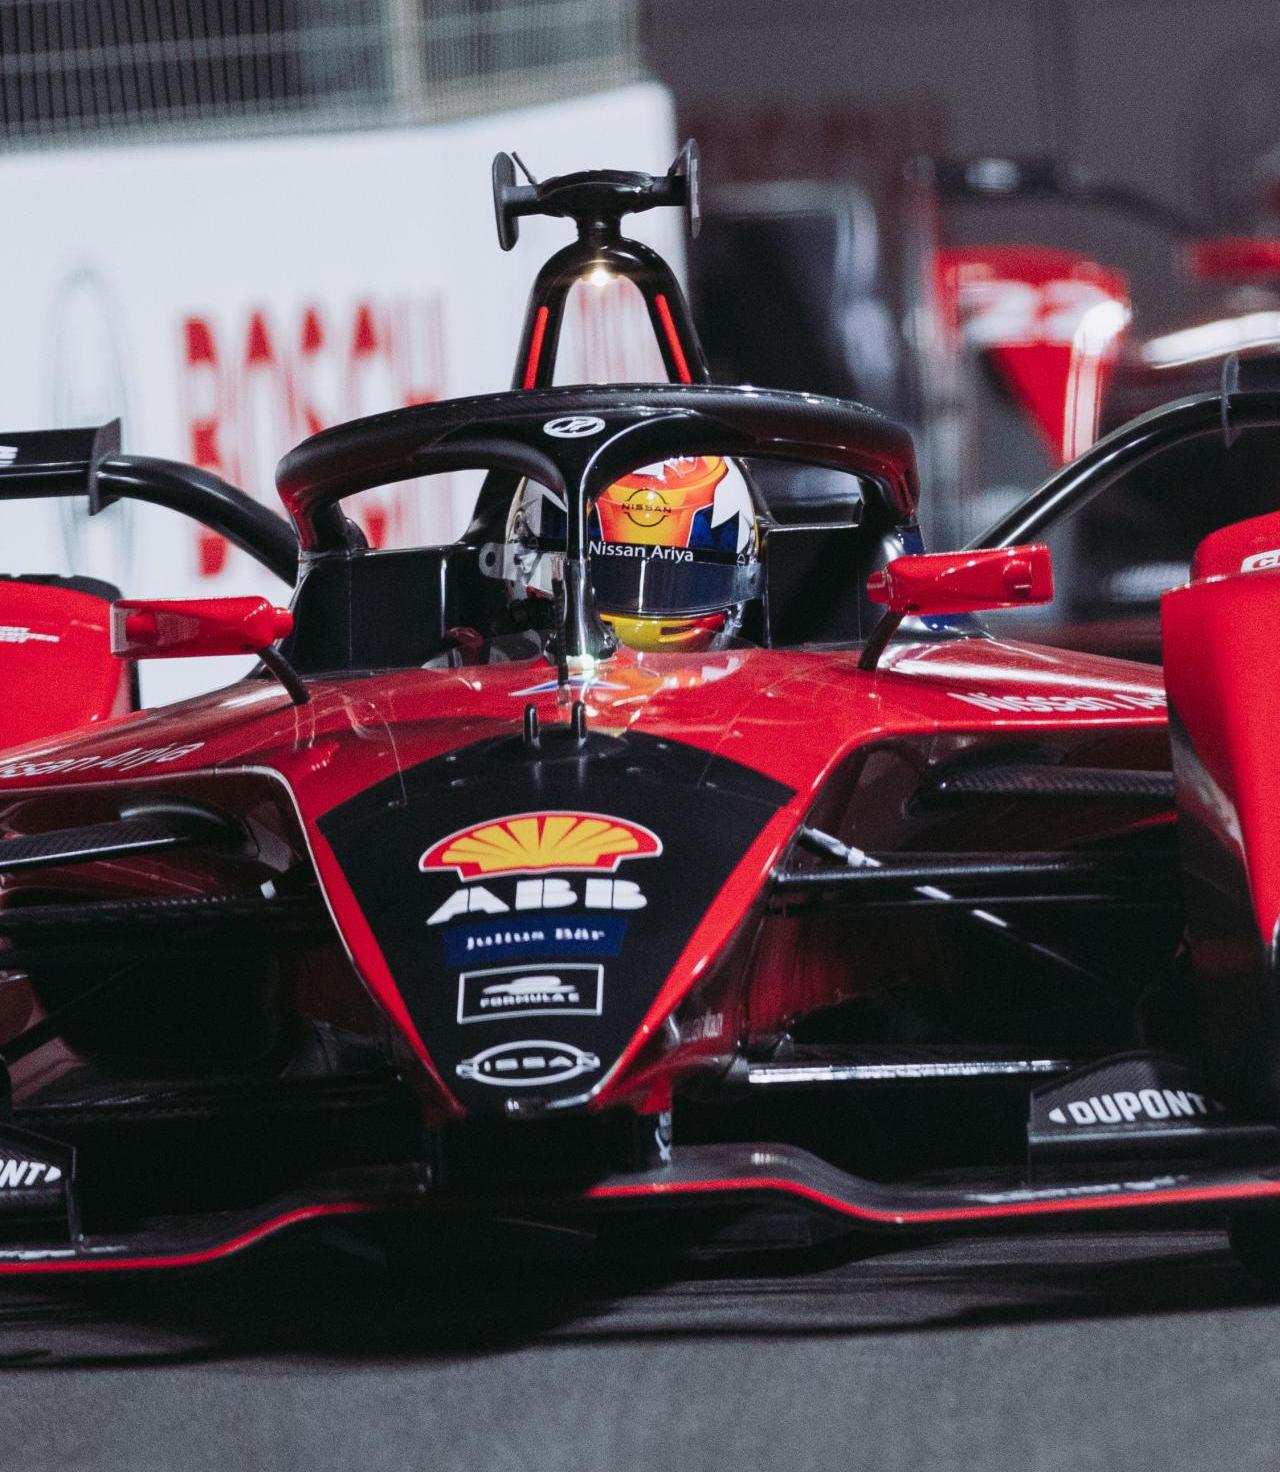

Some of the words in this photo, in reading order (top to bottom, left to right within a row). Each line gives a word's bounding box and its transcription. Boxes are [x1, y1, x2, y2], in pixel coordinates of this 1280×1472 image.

[622, 503, 672, 514] NISSAN
[588, 541, 647, 557] Nissan
[650, 545, 695, 564] Ariya
[426, 878, 648, 926] ABB
[480, 992, 565, 1009] FORMULA
[1066, 1088, 1208, 1125] DUPONT
